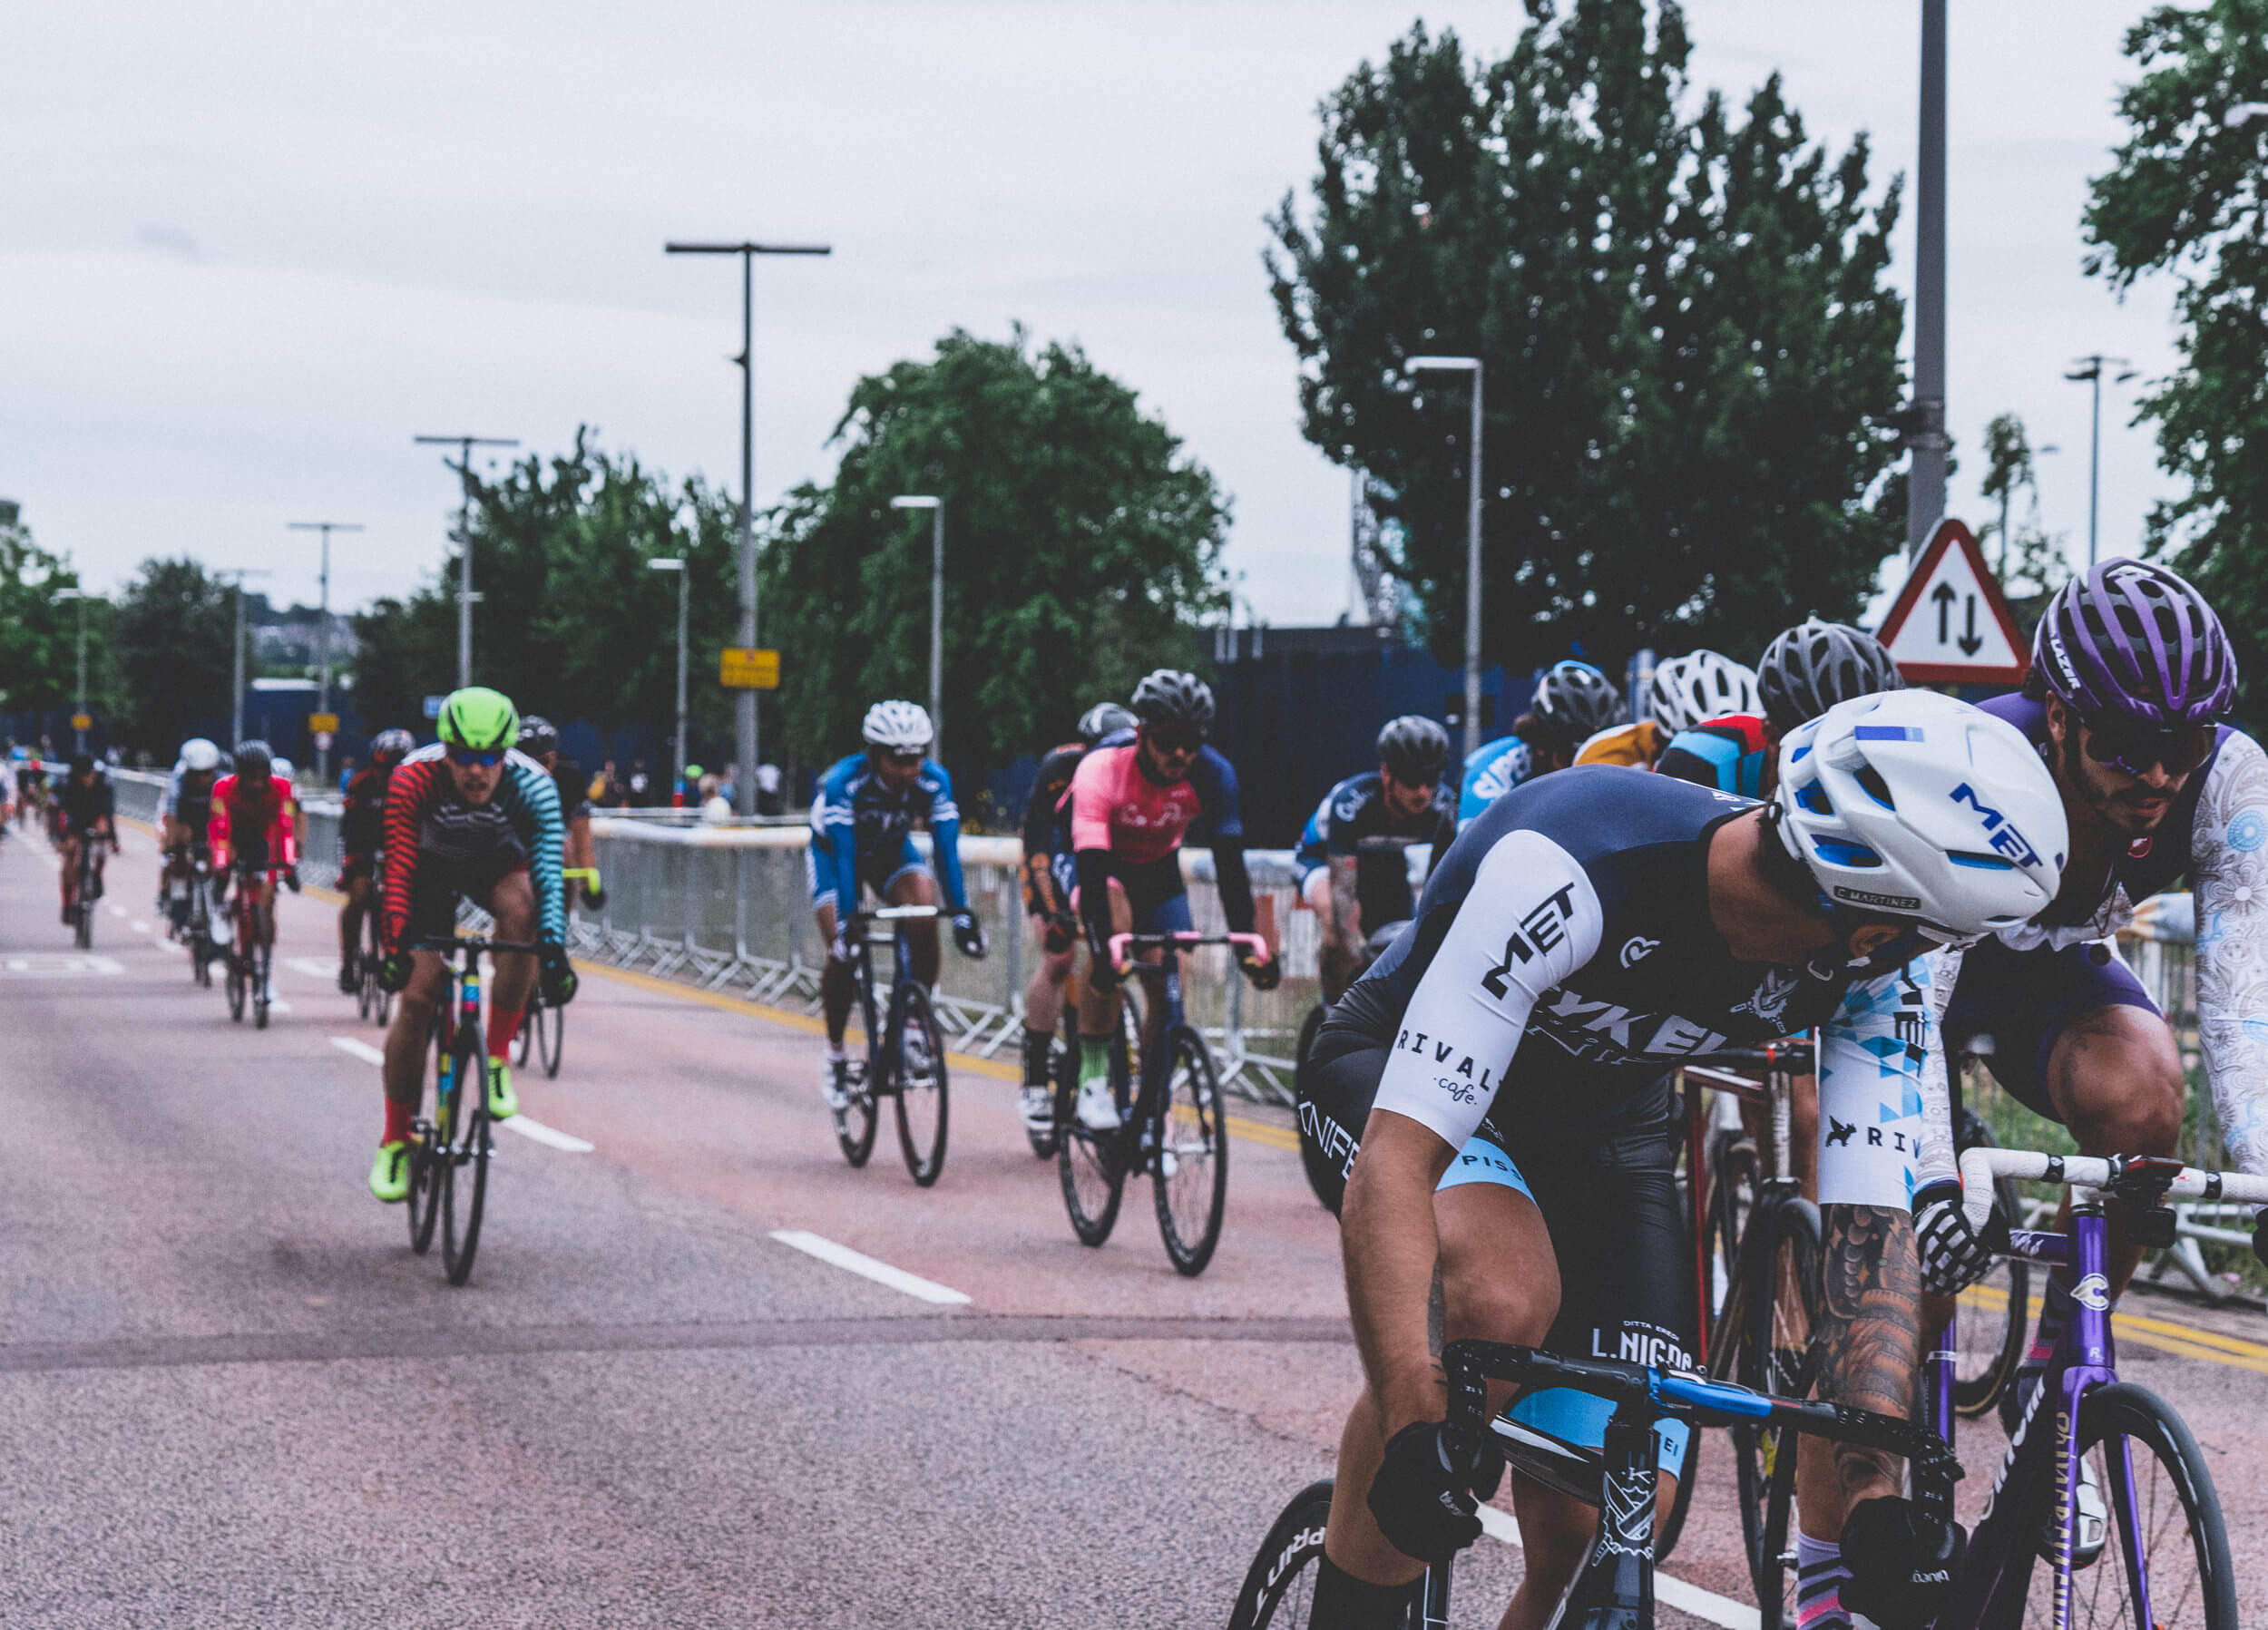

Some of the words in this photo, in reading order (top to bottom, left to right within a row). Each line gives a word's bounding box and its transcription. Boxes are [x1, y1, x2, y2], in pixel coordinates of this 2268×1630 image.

[2050, 639, 2081, 689] LAZER
[1948, 782, 2043, 866] MET
[1850, 892, 1917, 908] MARTINEZ
[1481, 881, 1576, 1000] MET
